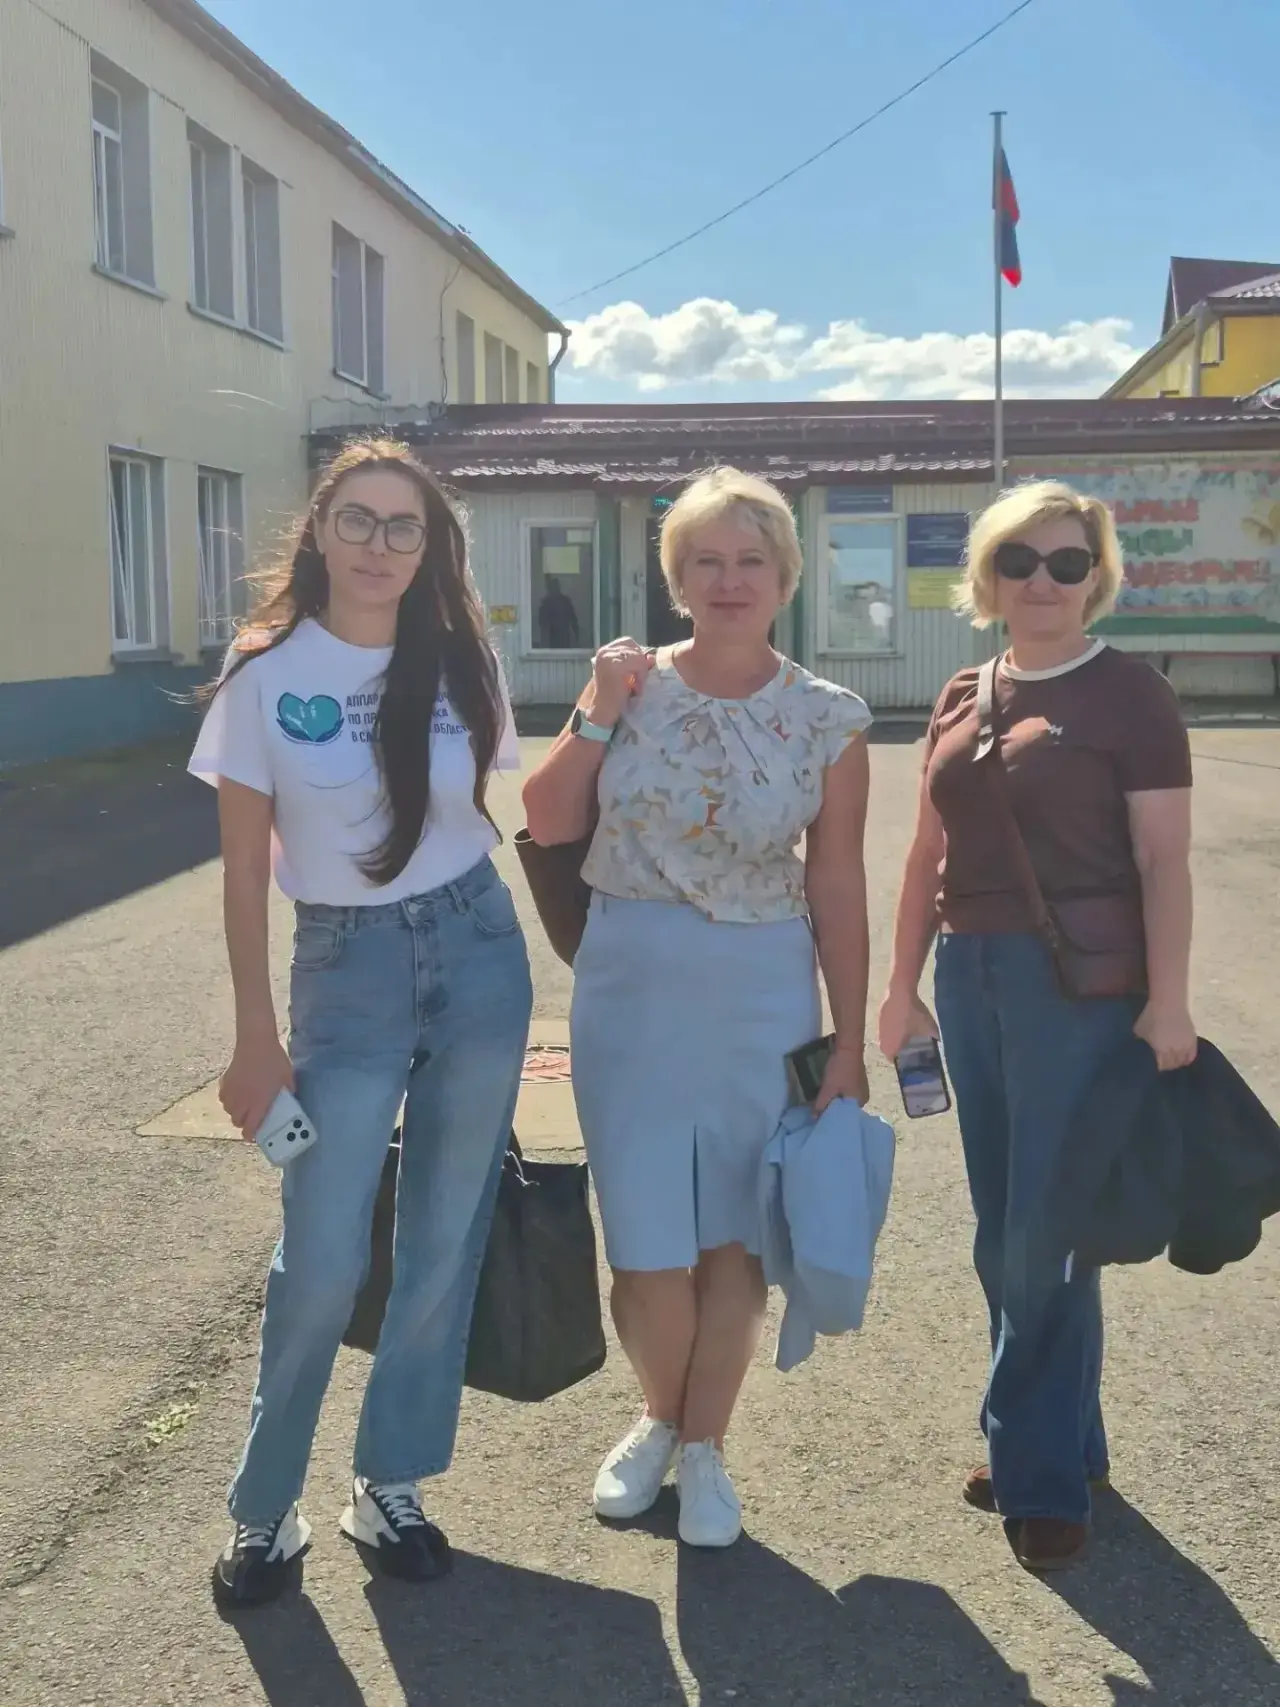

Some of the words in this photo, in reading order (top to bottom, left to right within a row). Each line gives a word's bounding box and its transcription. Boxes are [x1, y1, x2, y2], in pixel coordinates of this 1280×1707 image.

[346, 692, 378, 708] АППАР
[348, 713, 361, 725] ПО
[352, 731, 358, 743] В
